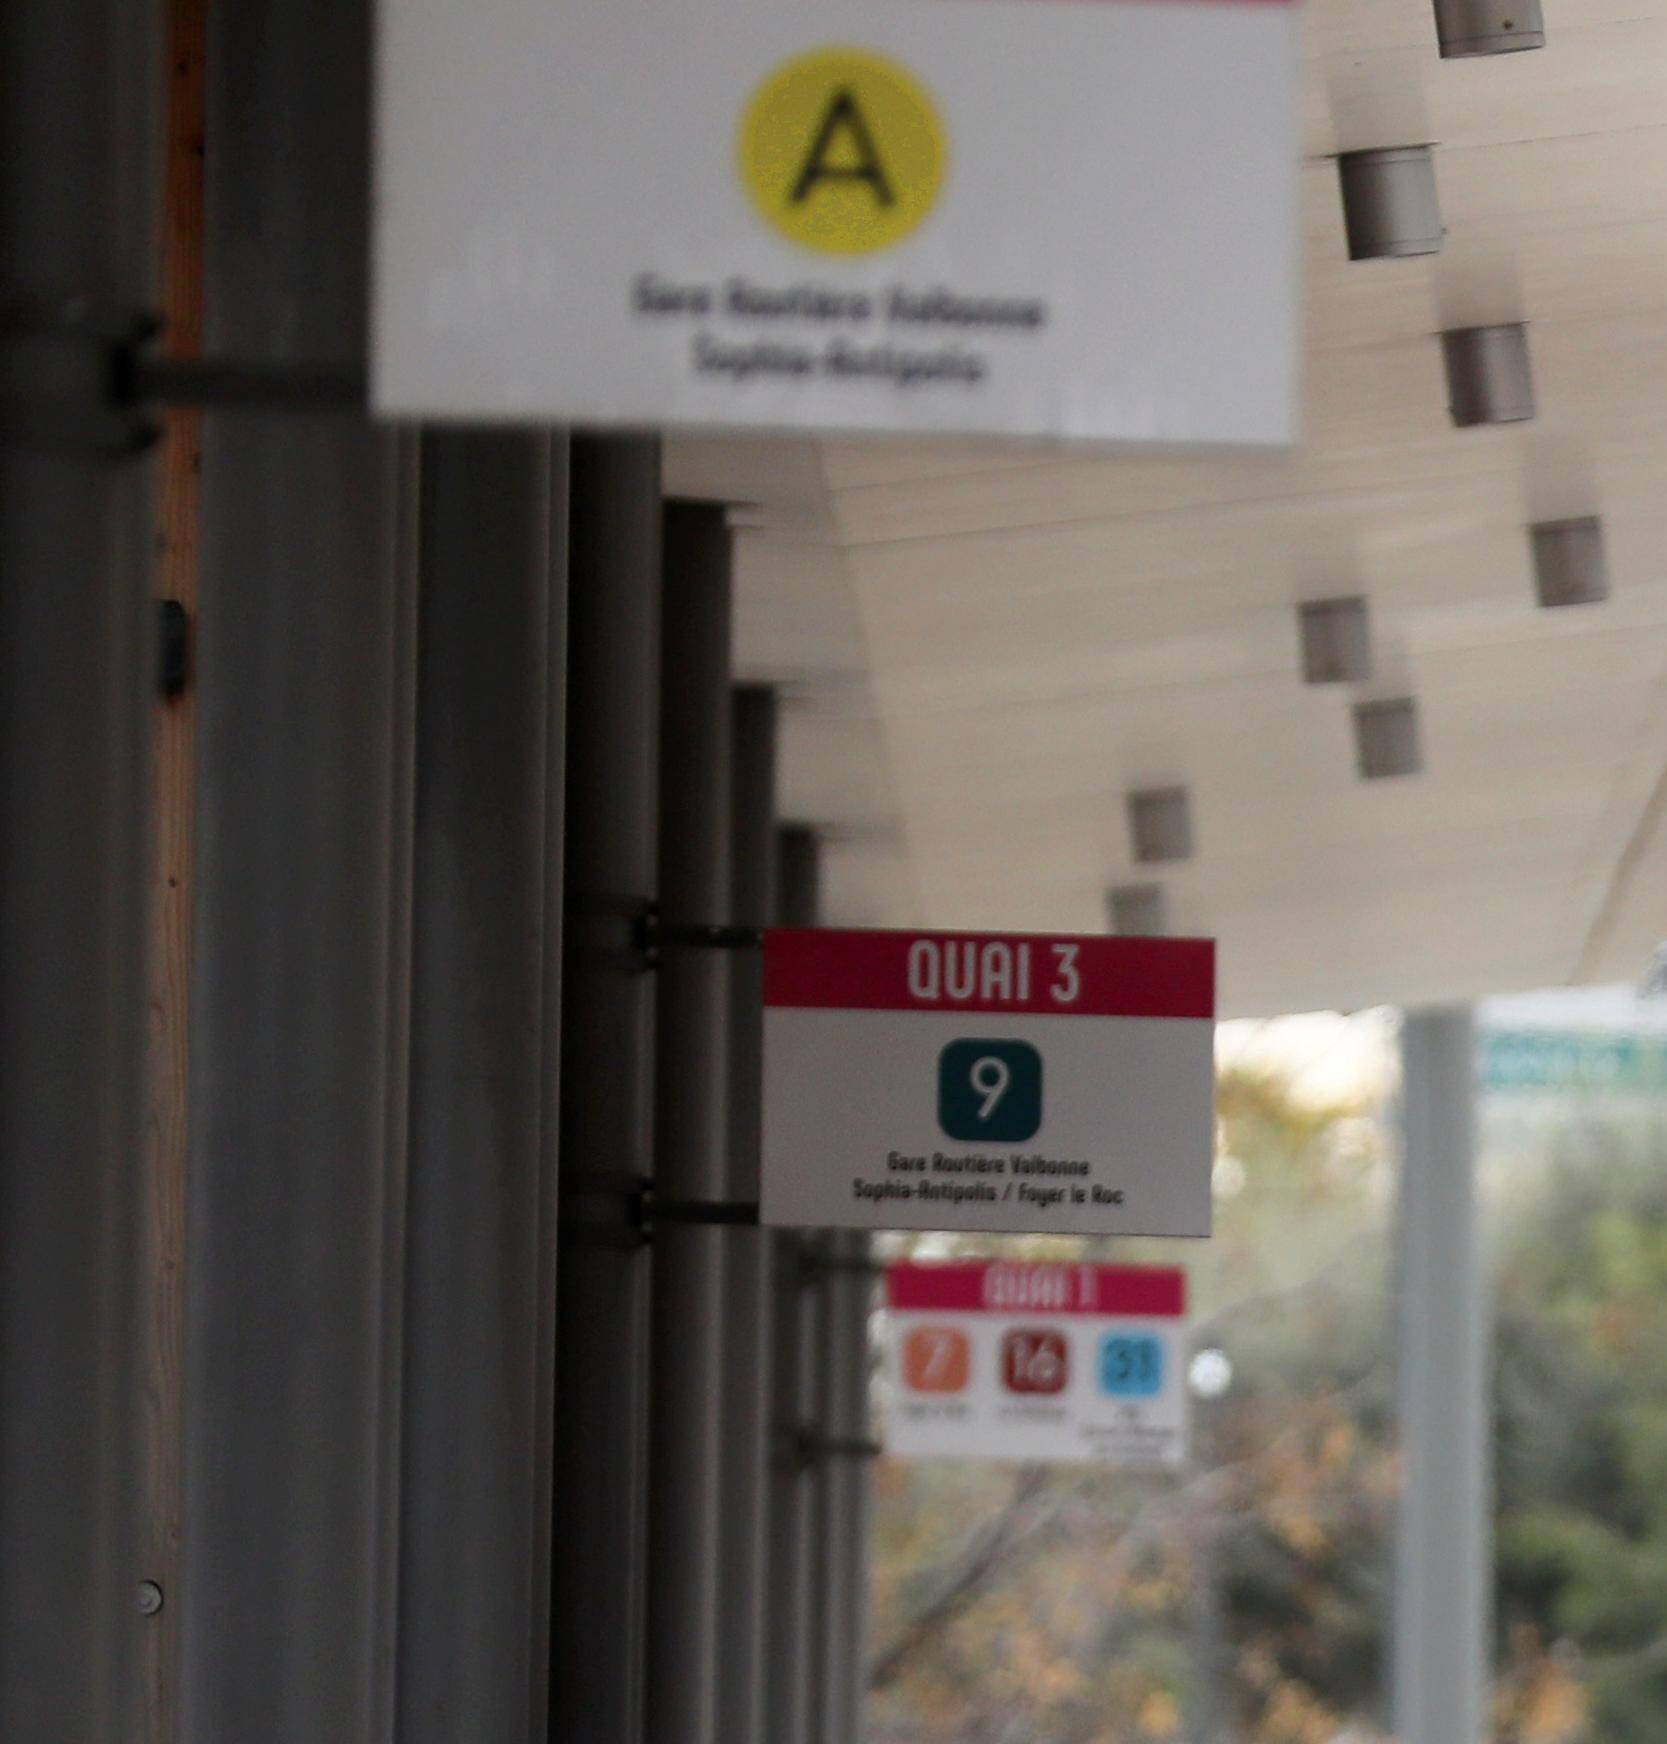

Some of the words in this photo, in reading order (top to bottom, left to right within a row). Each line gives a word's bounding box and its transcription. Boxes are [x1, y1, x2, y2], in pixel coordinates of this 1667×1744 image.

[790, 85, 894, 207] A
[907, 939, 1030, 1001] QUAI
[1050, 943, 1081, 1001] 3
[969, 1055, 1011, 1121] 9
[887, 1151, 926, 1173] Gare
[932, 1152, 1005, 1174] Routière
[1010, 1154, 1089, 1176] Valbonne
[853, 1177, 997, 1206] Sophia-Antipolis
[1018, 1183, 1066, 1208] Foyer
[1070, 1184, 1086, 1204] le
[1091, 1184, 1125, 1205] Roc
[1012, 1335, 1059, 1382] 16
